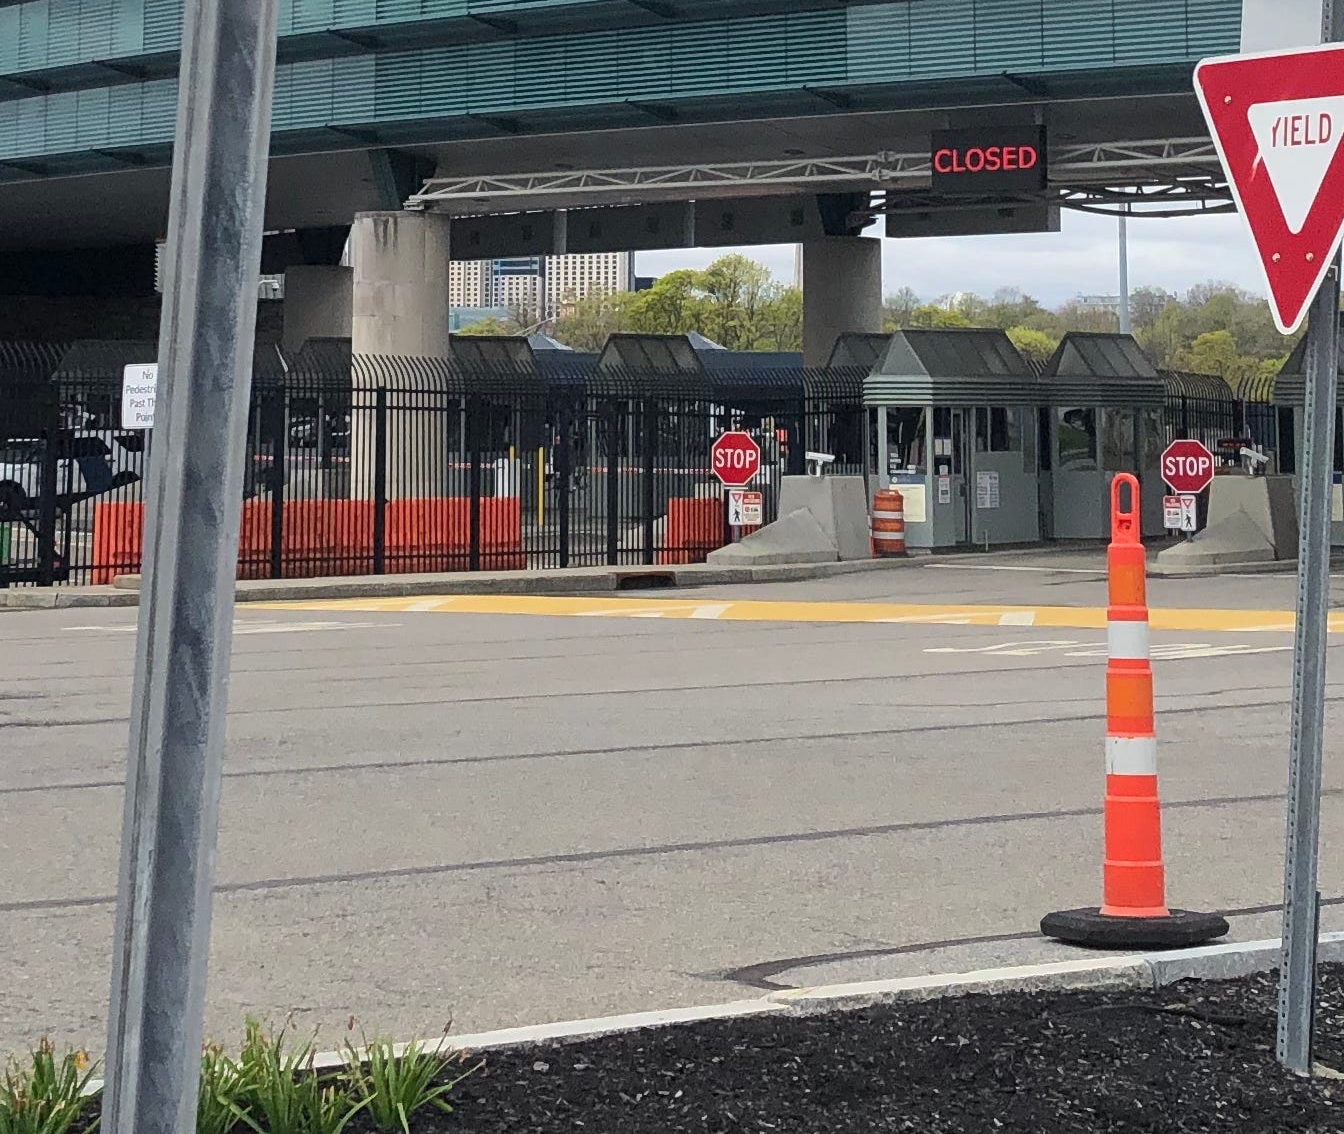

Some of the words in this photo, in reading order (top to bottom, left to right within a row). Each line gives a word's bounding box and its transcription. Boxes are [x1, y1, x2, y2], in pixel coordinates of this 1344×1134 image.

[1272, 113, 1332, 148] YIELD
[934, 146, 1037, 173] CLOSED
[715, 448, 756, 469] STOP
[1165, 456, 1210, 476] STOP
